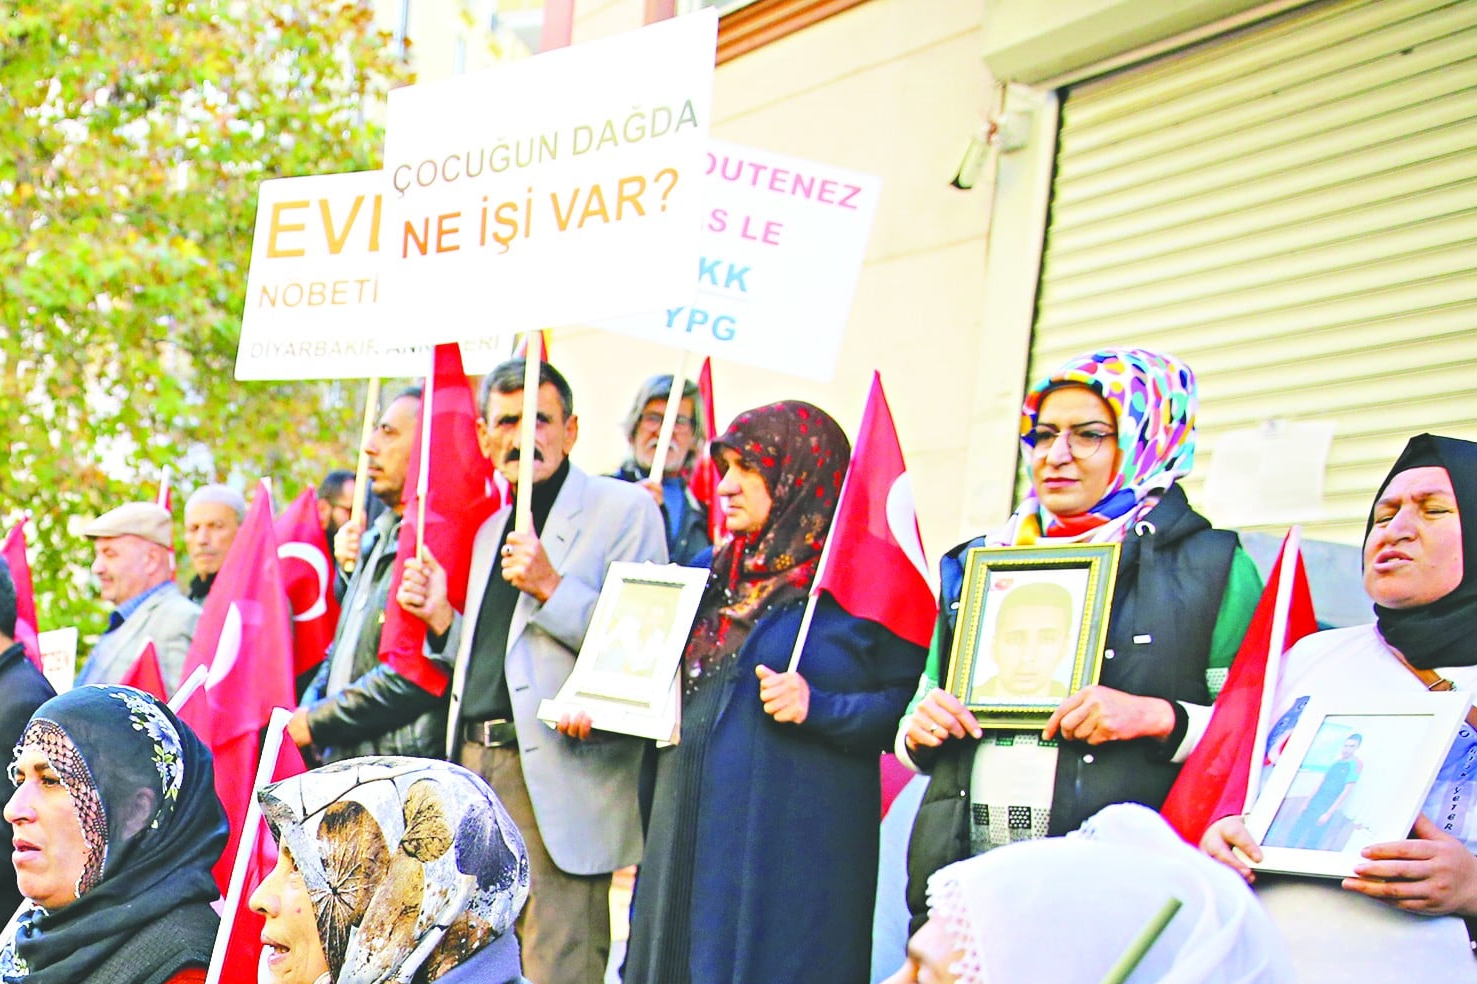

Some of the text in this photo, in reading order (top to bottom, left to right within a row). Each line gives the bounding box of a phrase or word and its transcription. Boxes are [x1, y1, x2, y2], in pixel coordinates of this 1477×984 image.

[393, 99, 699, 198] ÇOCUĞUN DAĞDA
[401, 167, 679, 260] NE İŞİ VAR?
[739, 215, 784, 246] LE
[258, 273, 379, 308] NÖBETİ
[665, 305, 738, 341] YPG
